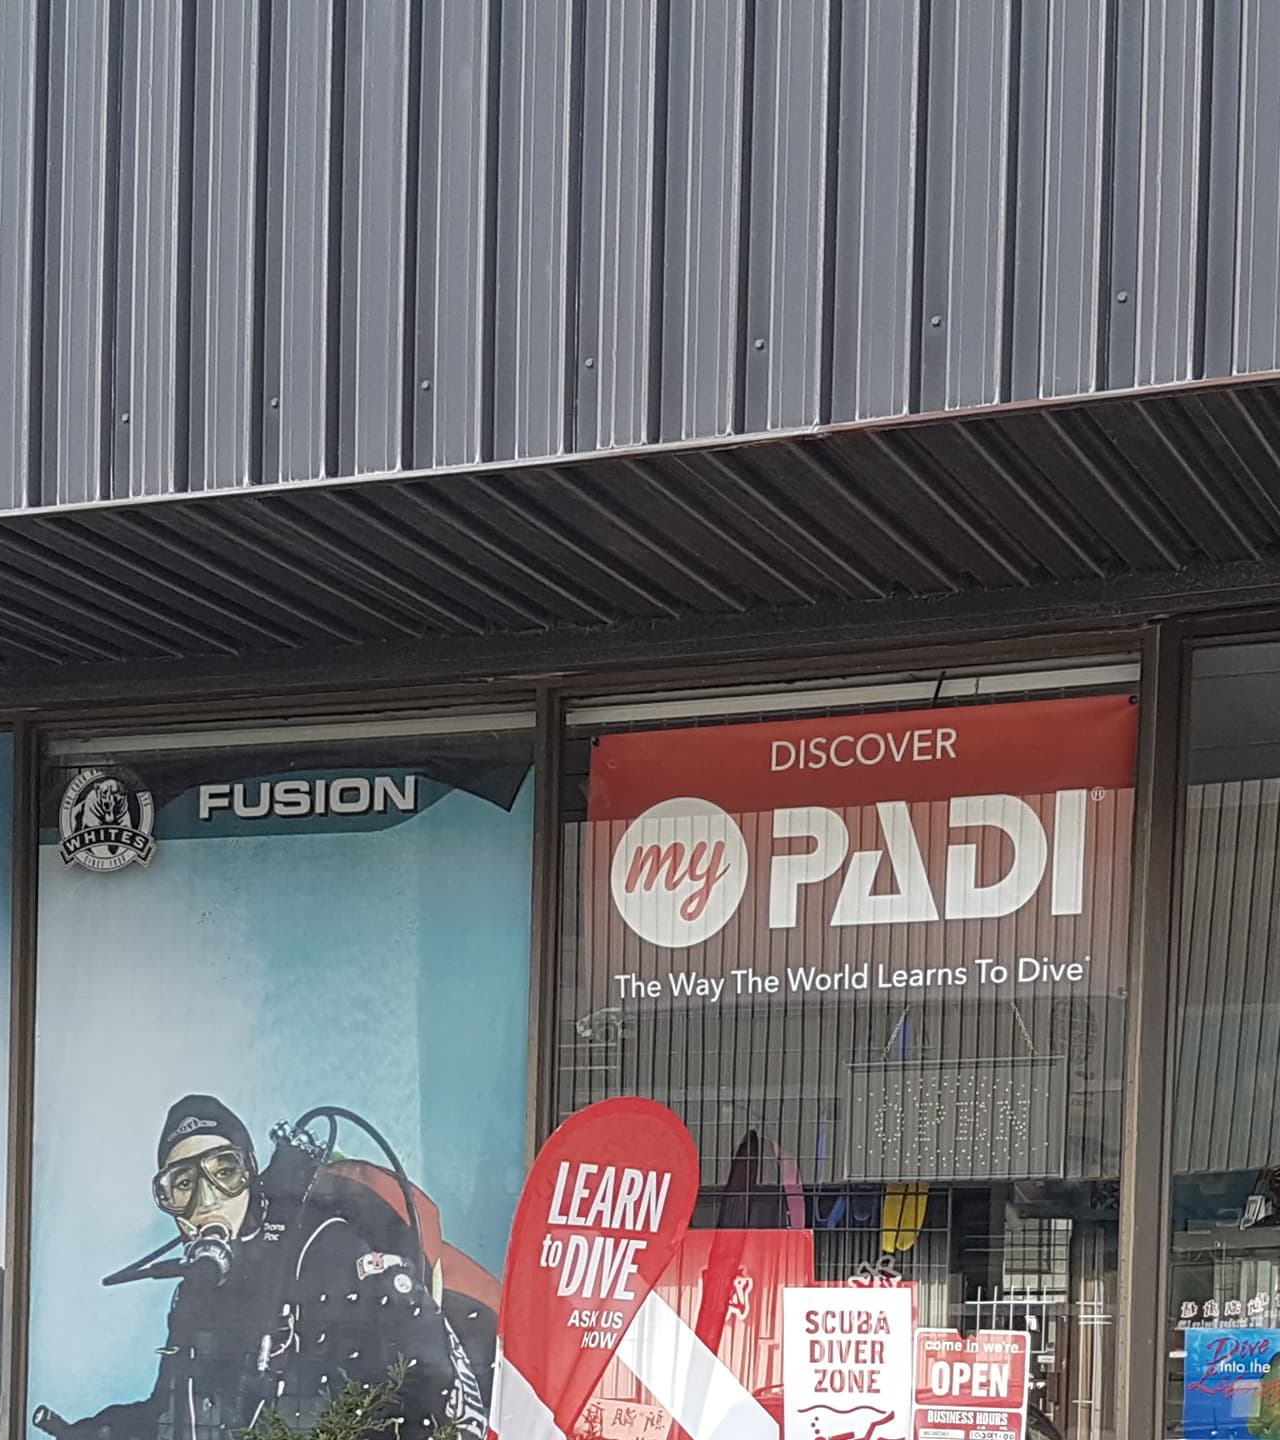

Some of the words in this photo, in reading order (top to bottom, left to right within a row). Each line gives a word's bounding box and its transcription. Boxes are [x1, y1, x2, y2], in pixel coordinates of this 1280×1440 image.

[770, 727, 958, 771] DISCOVER
[199, 775, 416, 819] FUSION
[65, 829, 146, 852] WHITES
[624, 839, 731, 922] my
[768, 789, 1088, 929] PADI
[614, 973, 662, 999] The
[668, 970, 724, 1002] Way
[731, 968, 780, 994] The
[787, 963, 868, 992] World
[878, 958, 968, 988] Learns
[974, 957, 1008, 983] To
[1018, 954, 1084, 982] Dive
[547, 1161, 672, 1233] LEARN
[540, 1233, 563, 1268] to
[556, 1234, 648, 1301] DIVE
[567, 1309, 600, 1328] ASK
[600, 1311, 624, 1329] US
[805, 1309, 891, 1335] SCUBA
[580, 1331, 618, 1350] HOW
[808, 1339, 885, 1364] DIVER
[924, 1340, 963, 1352] come
[967, 1339, 979, 1352] in
[983, 1341, 1020, 1352] we're
[1206, 1336, 1271, 1367] Dive
[931, 1360, 1010, 1399] OPEN
[1250, 1360, 1271, 1373] the
[813, 1368, 881, 1394] ZONE
[927, 1410, 974, 1425] BUSINESS
[976, 1412, 1008, 1426] HOURS
